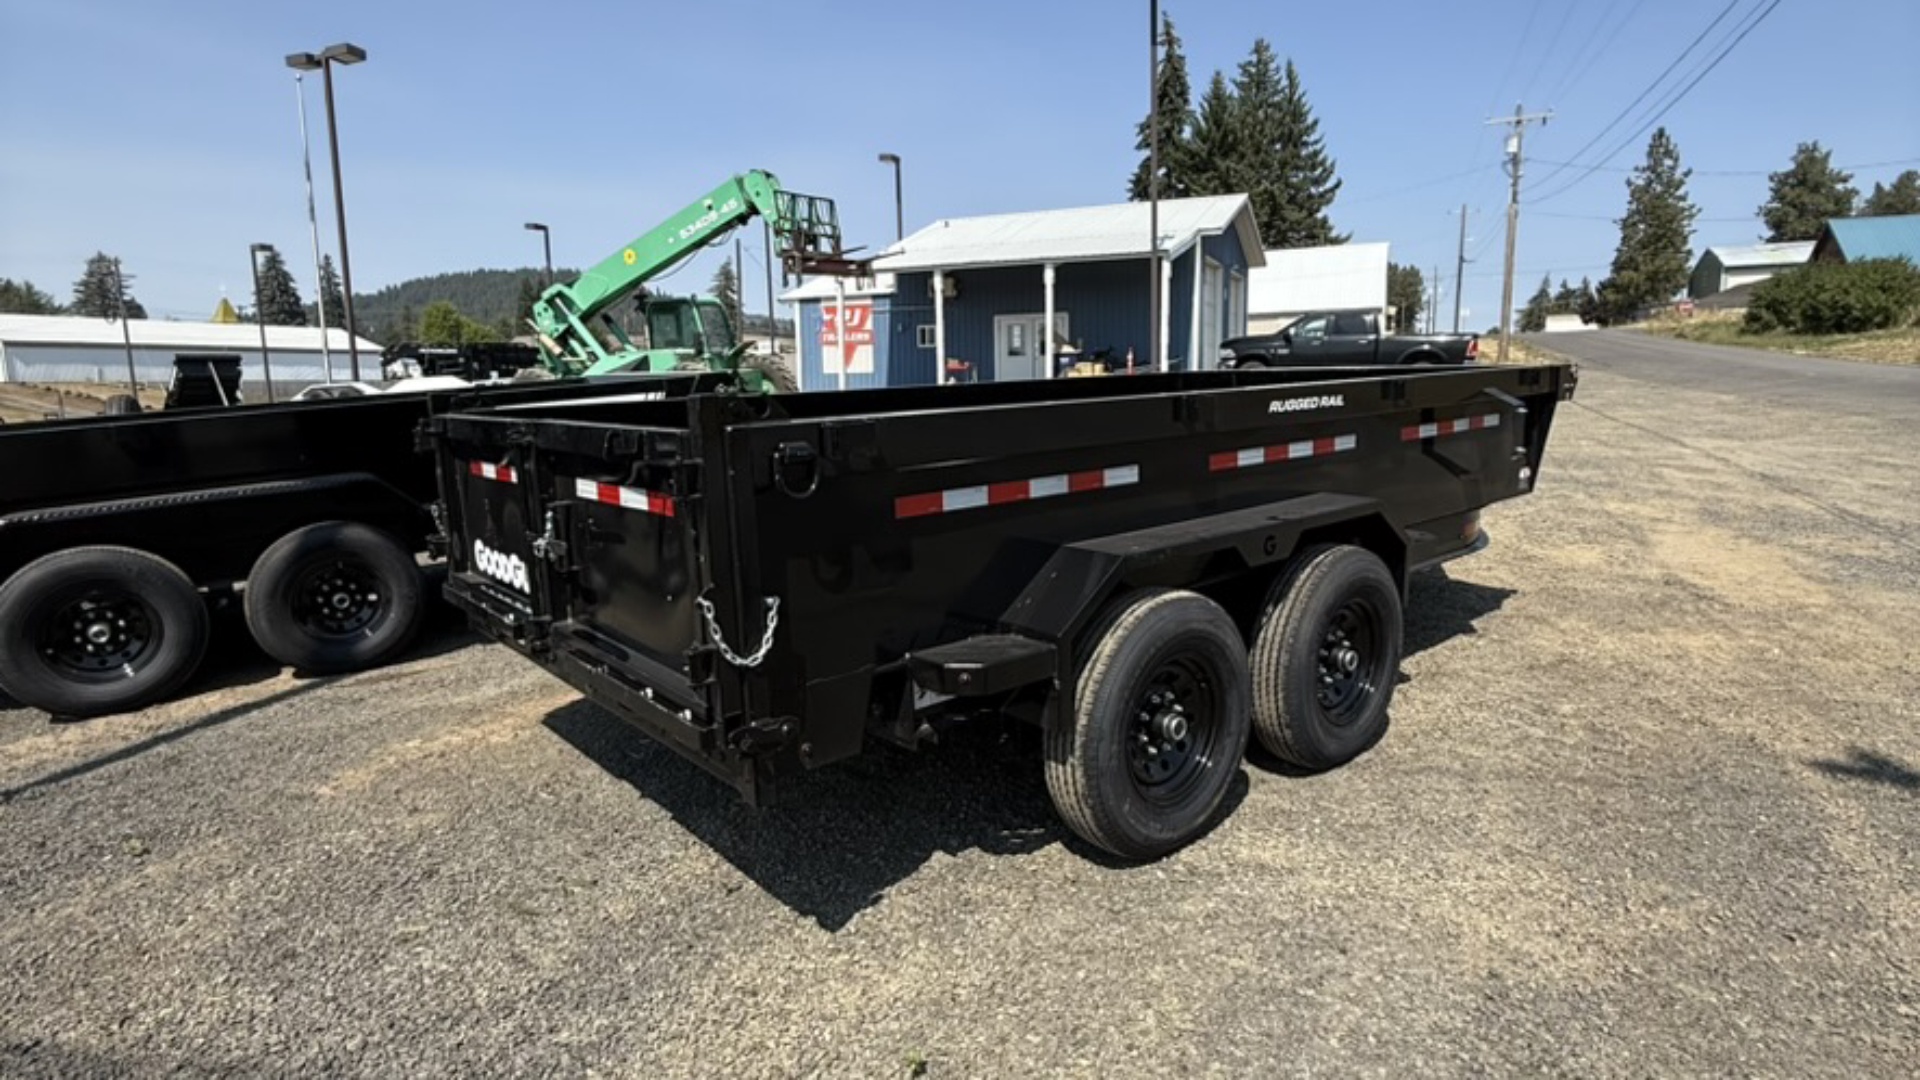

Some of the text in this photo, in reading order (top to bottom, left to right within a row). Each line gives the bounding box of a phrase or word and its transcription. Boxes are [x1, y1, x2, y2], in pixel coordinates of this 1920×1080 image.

[822, 332, 871, 343] TRLERS
[1268, 394, 1344, 413] RUGGED RAIL
